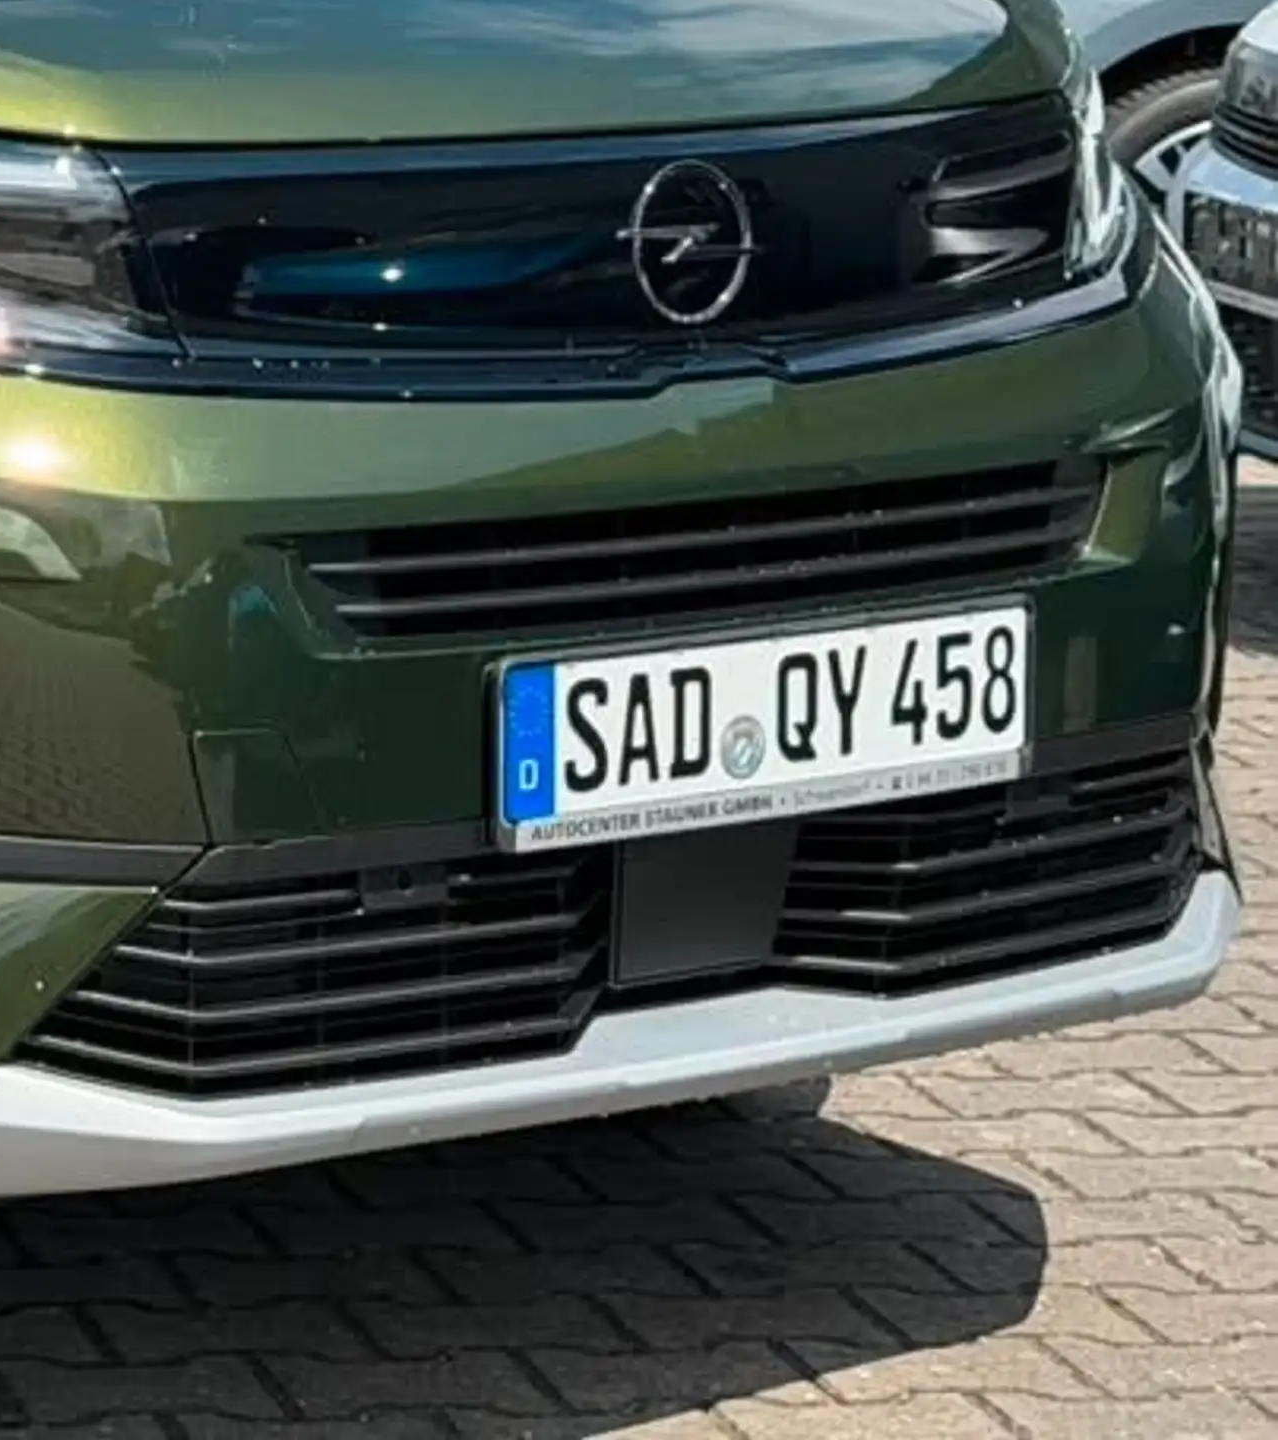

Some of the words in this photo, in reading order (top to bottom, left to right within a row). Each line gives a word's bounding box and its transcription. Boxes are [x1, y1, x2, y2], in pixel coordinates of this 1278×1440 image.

[564, 665, 711, 793] SAD
[776, 643, 867, 762] QY
[890, 625, 1016, 747] 458
[518, 758, 539, 792] D
[531, 812, 641, 841] AUTOCENTER
